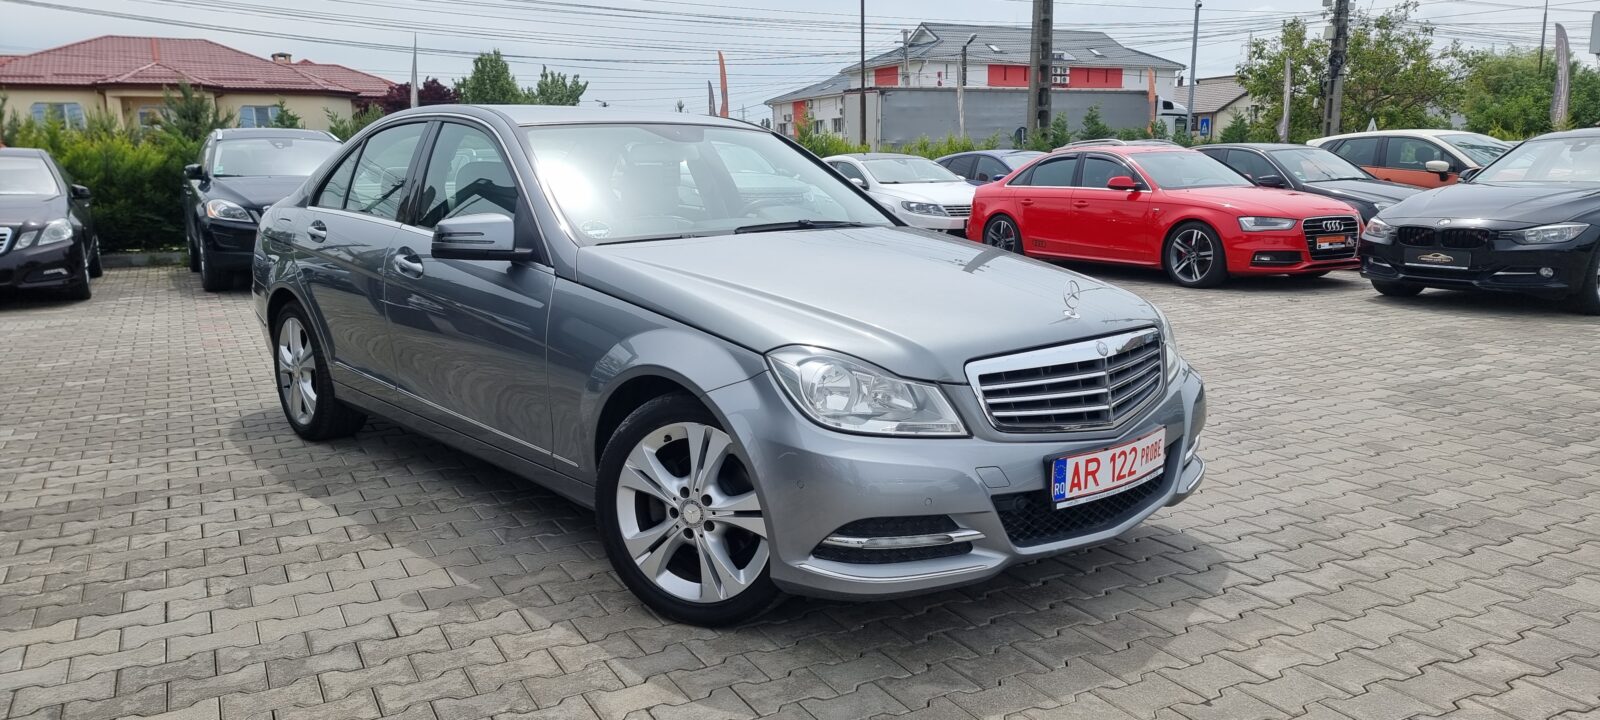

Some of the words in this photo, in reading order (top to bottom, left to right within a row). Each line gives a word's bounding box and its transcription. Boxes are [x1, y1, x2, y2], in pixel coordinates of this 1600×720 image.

[1069, 457, 1101, 493] AR
[1110, 446, 1138, 482] 122
[1140, 439, 1162, 466] PROBE
[1054, 482, 1065, 495] RO
